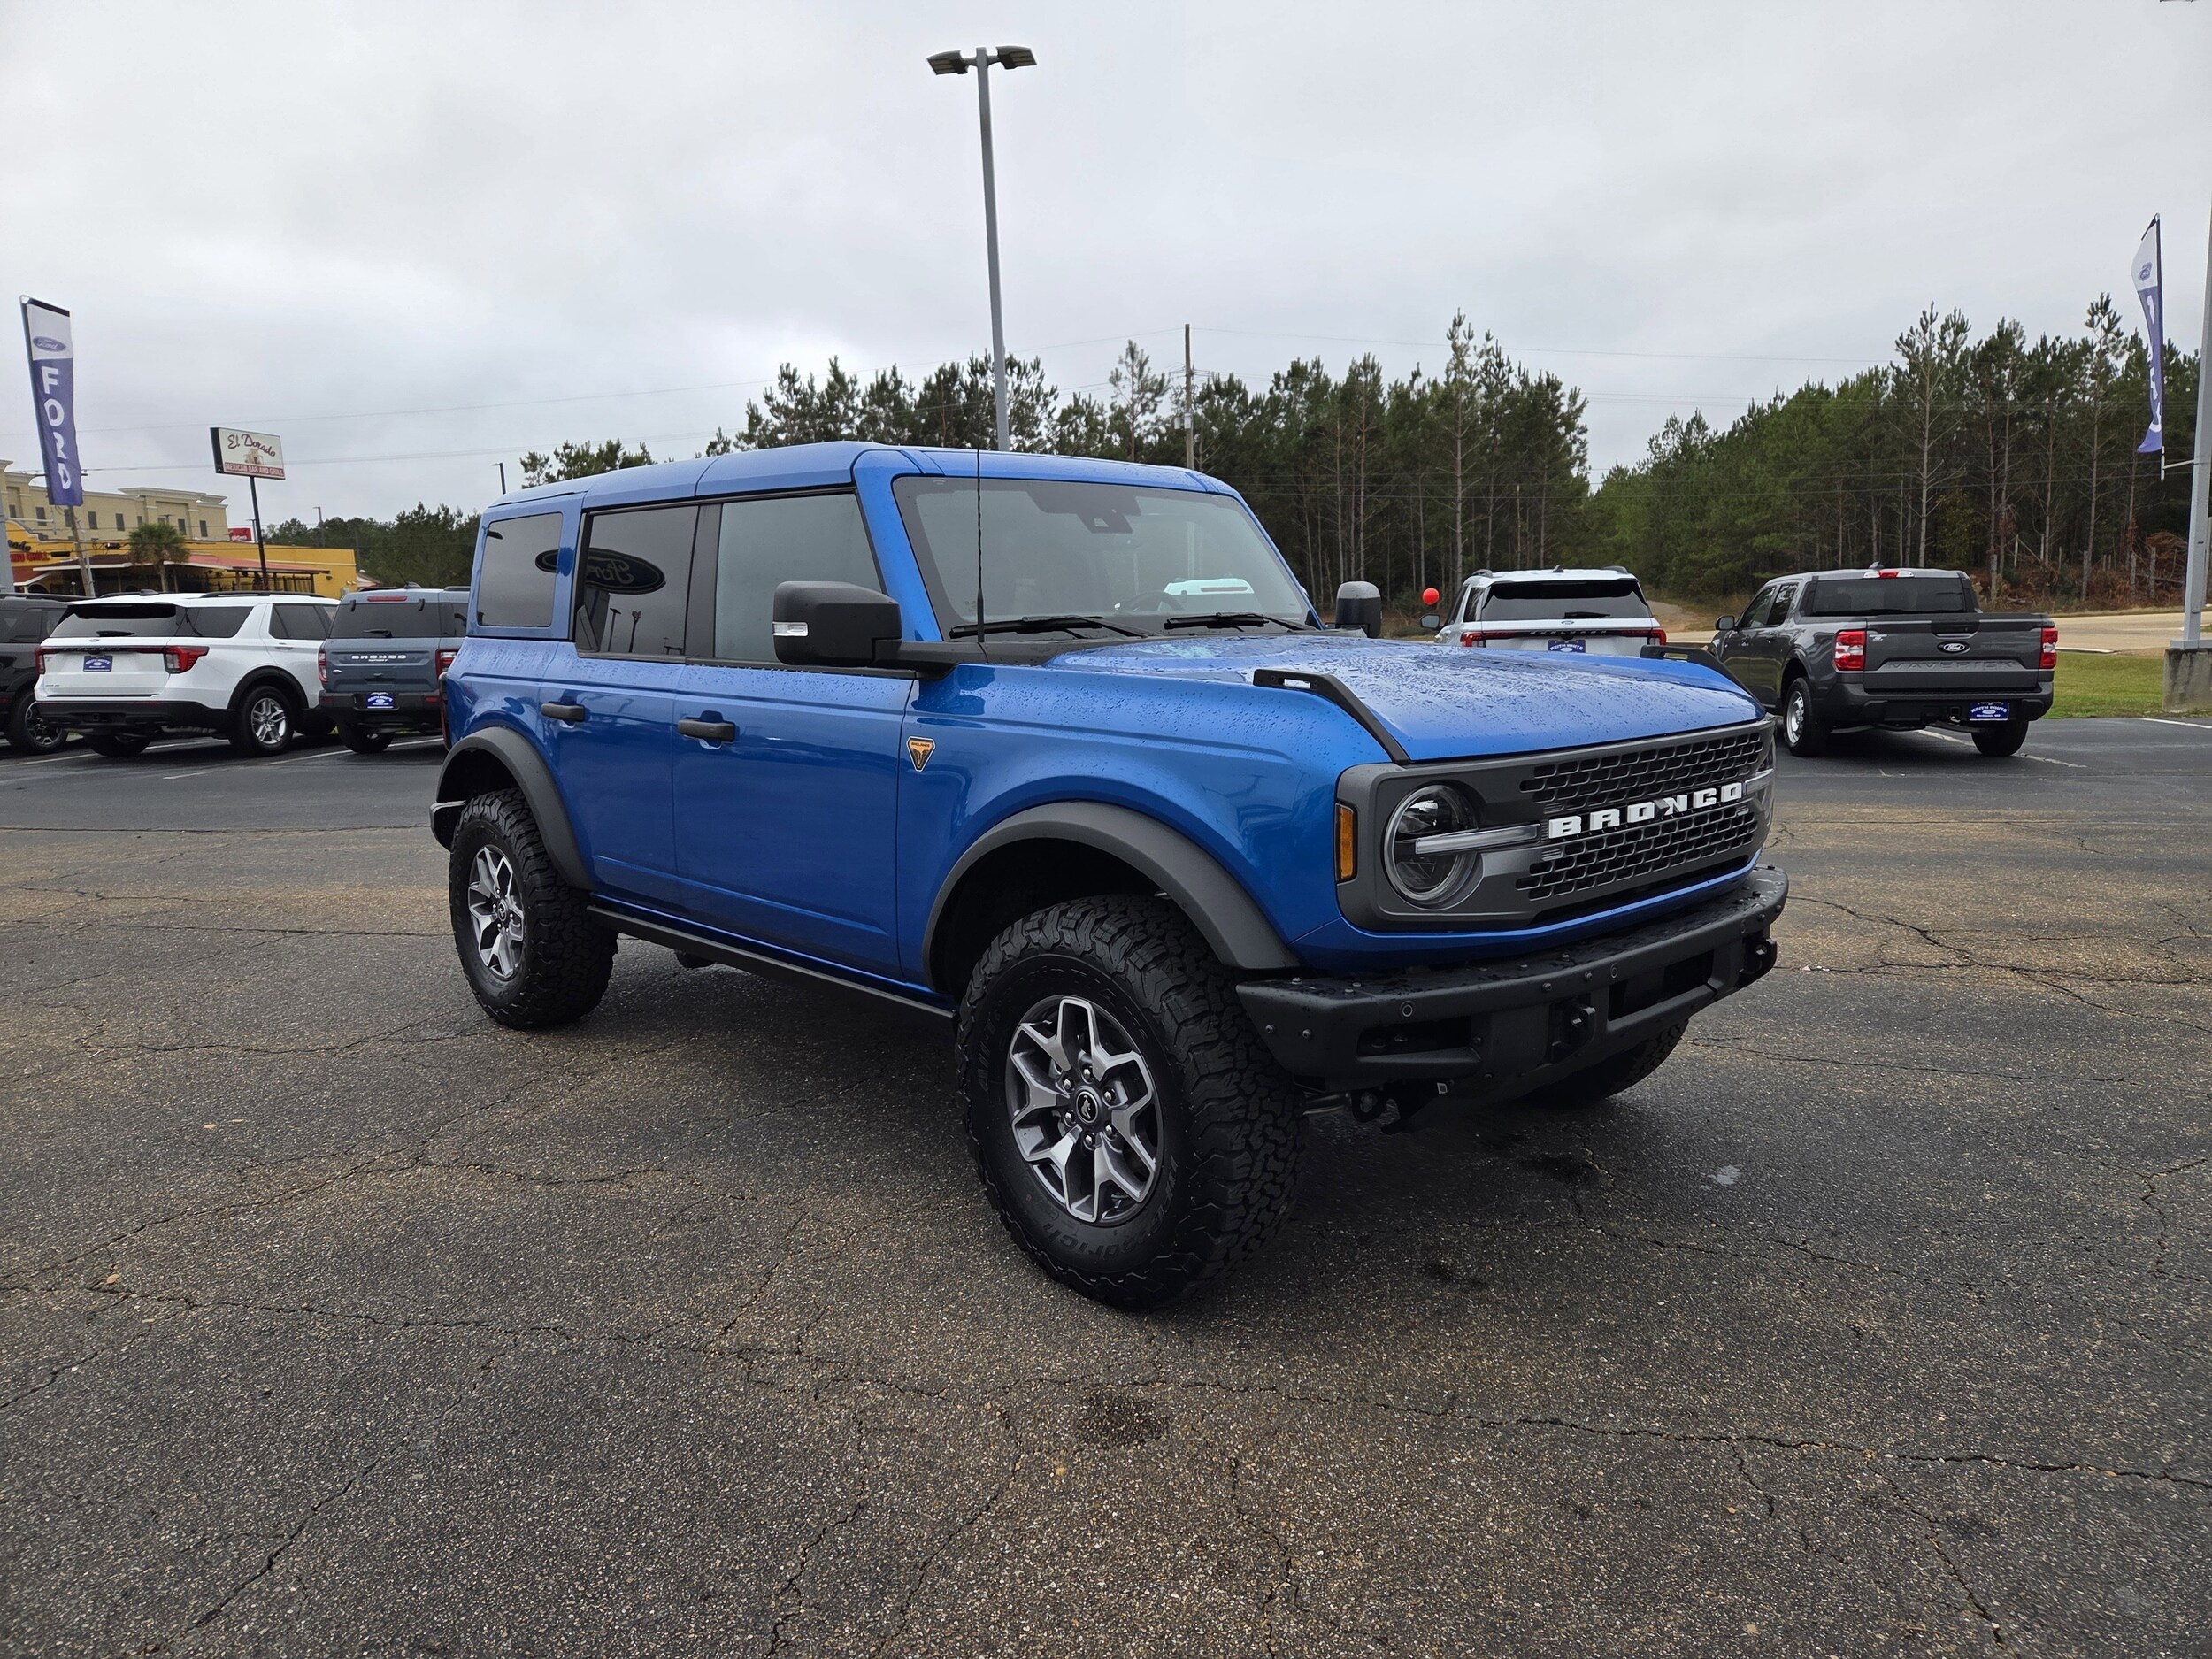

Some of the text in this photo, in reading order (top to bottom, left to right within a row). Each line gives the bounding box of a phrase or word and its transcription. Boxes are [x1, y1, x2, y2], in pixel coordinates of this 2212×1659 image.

[41, 365, 72, 489] FORD
[227, 434, 276, 457] El Dorado
[248, 465, 259, 473] BAR
[259, 465, 269, 474] AND
[269, 467, 284, 476] GRILL
[7, 539, 32, 552] rado
[1886, 661, 2016, 671] MAVERICK
[1548, 782, 1743, 840] BRONCO
